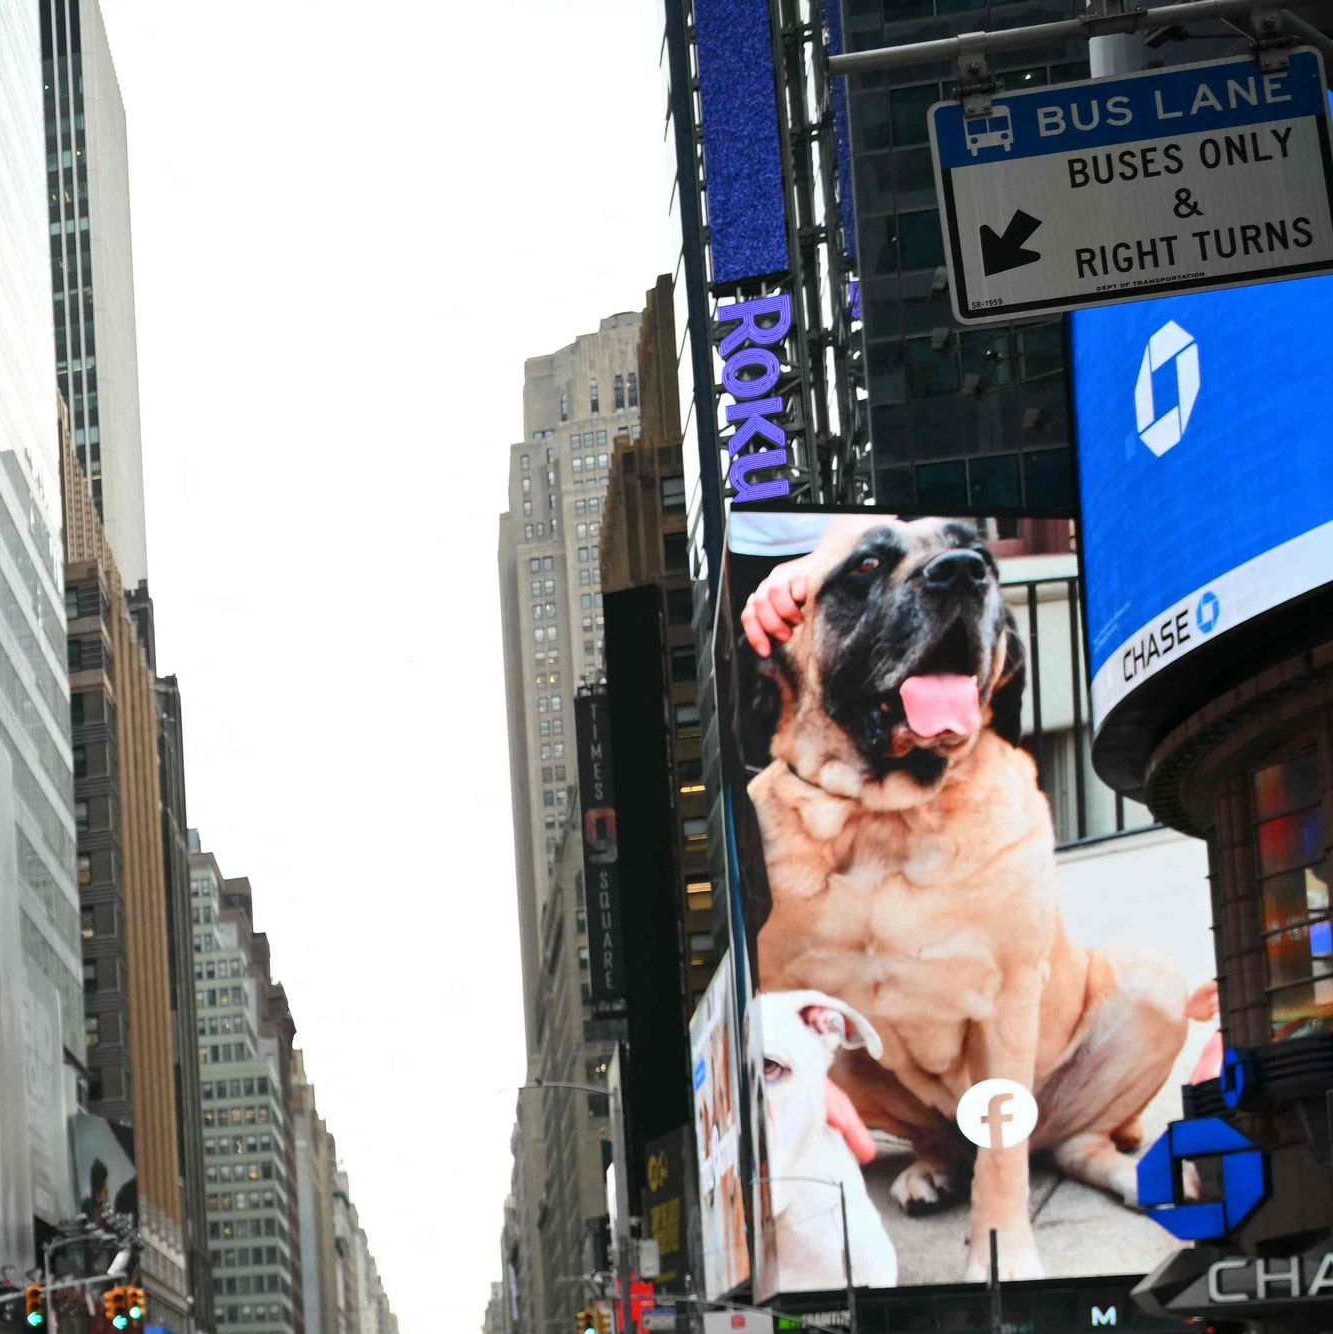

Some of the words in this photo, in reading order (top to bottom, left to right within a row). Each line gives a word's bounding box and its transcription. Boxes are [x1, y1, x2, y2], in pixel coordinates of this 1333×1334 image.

[1037, 96, 1133, 138] BUS
[1154, 73, 1292, 120] LANE
[1068, 143, 1184, 188] BUSES
[1200, 127, 1293, 169] ONLY
[1173, 188, 1204, 219] &
[1075, 235, 1178, 279] RIGHT
[1192, 217, 1314, 262] TURNS
[971, 298, 1003, 310] SR-1959
[1096, 283, 1117, 292] DEPT
[1119, 281, 1130, 289] OF
[1132, 272, 1205, 287] TRANSPORTATION
[1123, 609, 1190, 682] CHASE
